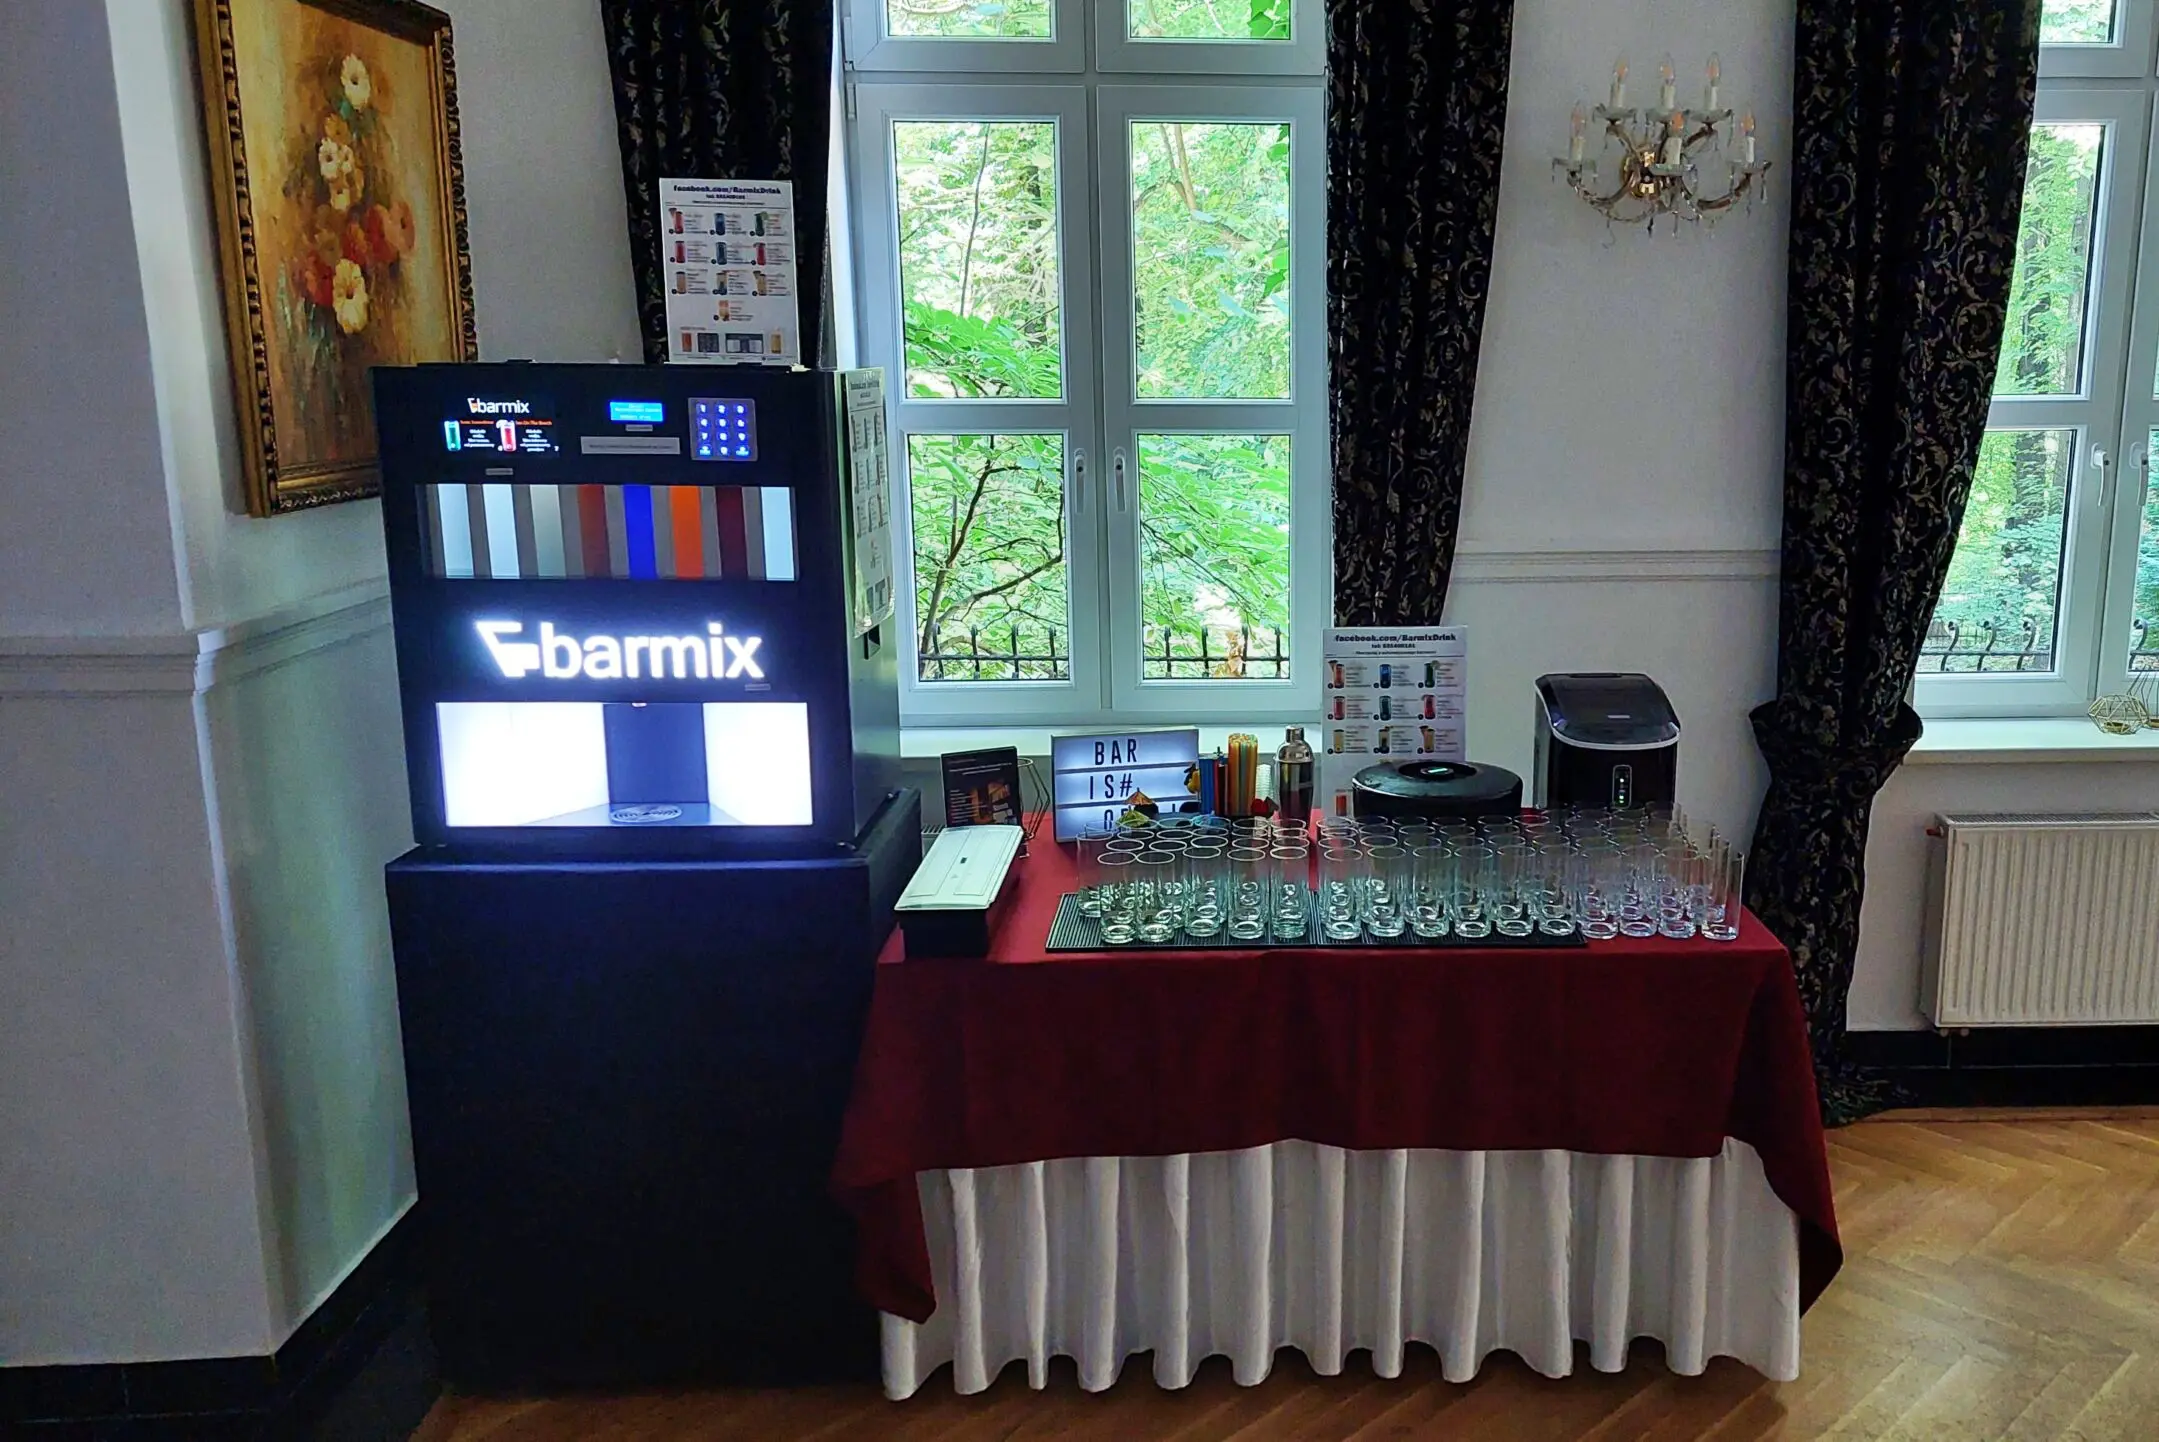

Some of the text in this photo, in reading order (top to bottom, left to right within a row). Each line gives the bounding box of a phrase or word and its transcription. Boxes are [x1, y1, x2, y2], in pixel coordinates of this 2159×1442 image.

[476, 398, 530, 414] barmix
[1335, 633, 1457, 642] facebook.com/BarmixDrink
[540, 621, 765, 681] barmix
[1094, 738, 1138, 766] BAR
